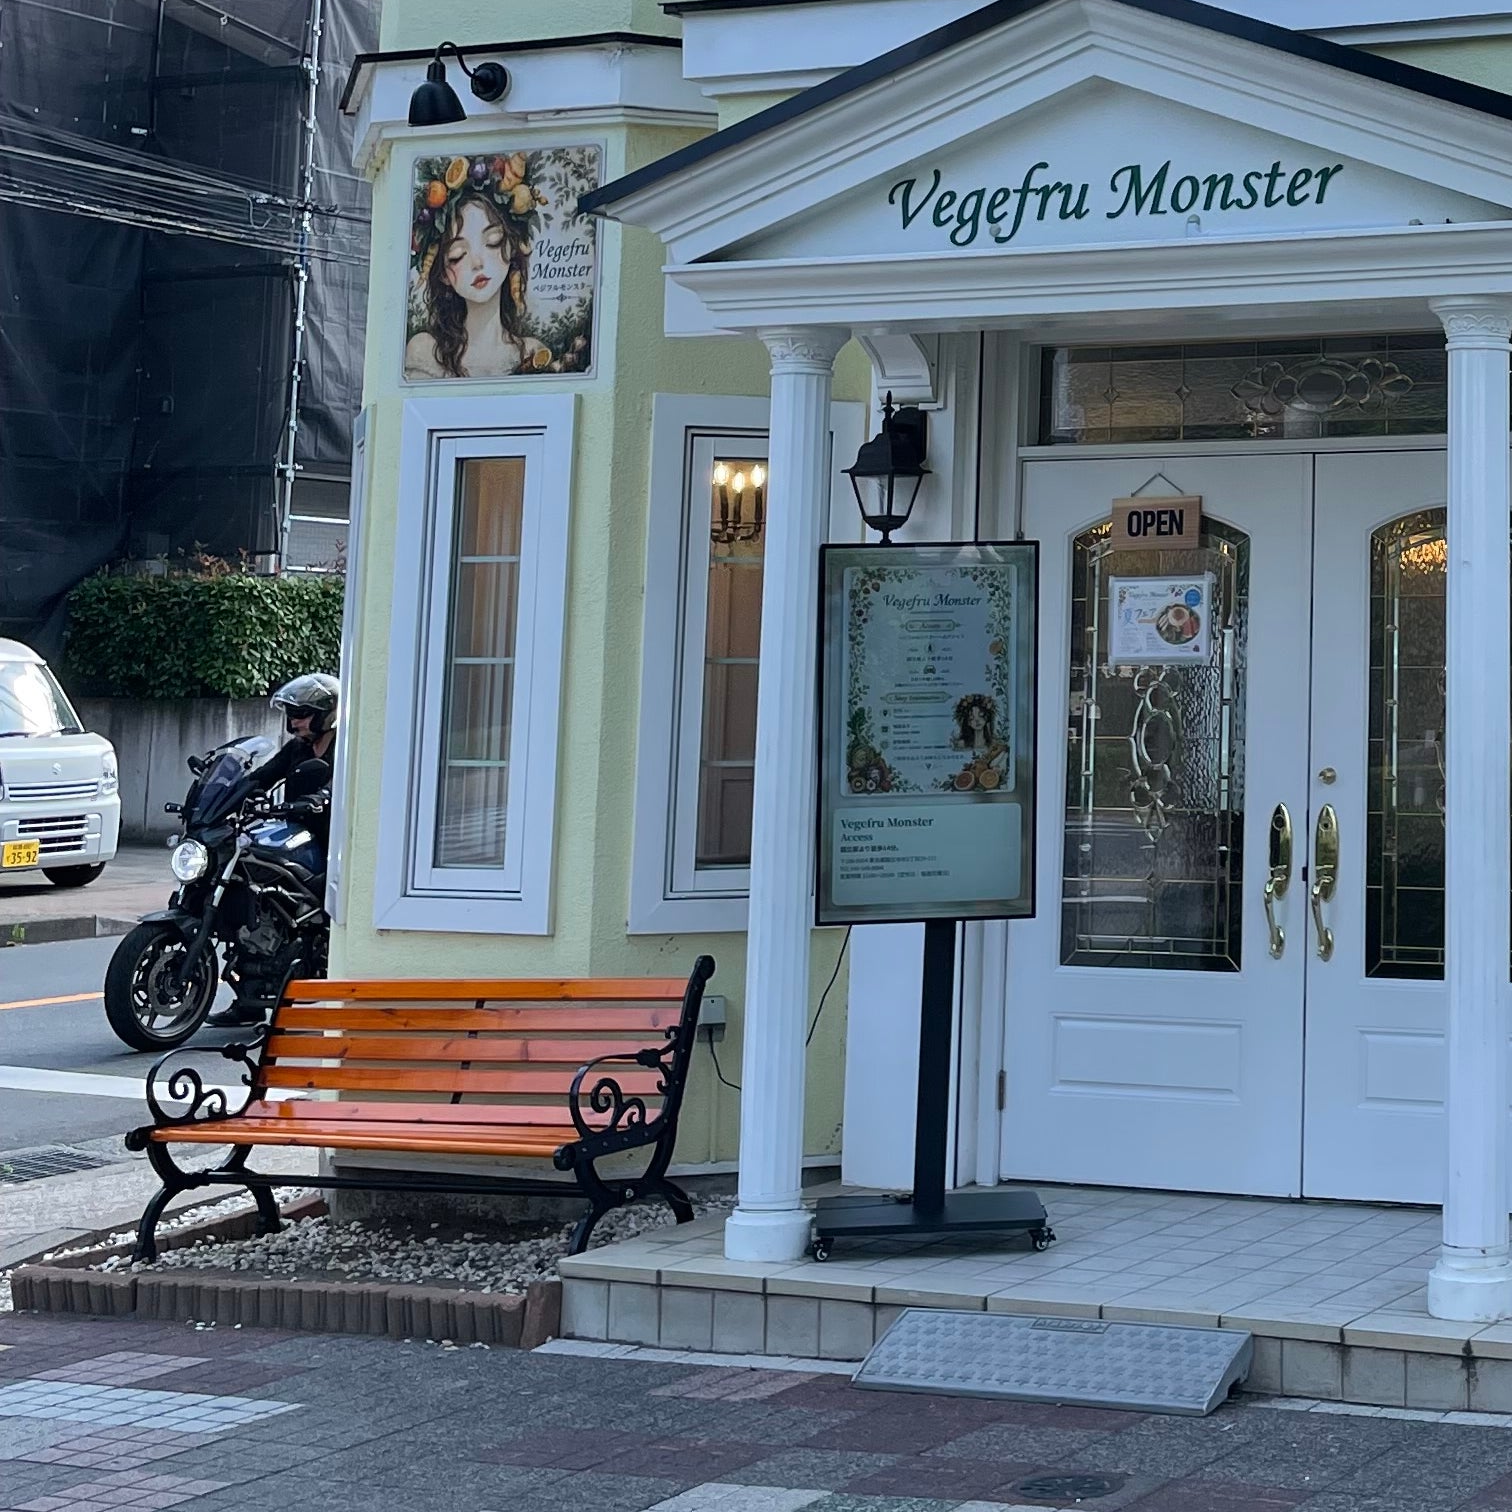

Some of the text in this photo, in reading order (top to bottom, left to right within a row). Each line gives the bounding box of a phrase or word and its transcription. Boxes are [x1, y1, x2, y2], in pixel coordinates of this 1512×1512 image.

[888, 160, 1343, 246] Vegefru Monster
[535, 238, 590, 263] Vegefru
[531, 263, 593, 280] Monster
[1127, 509, 1184, 537] OPEN
[882, 593, 982, 611] Vegefru Monster
[840, 816, 934, 831] Vegefru Monster
[840, 833, 873, 842] Access
